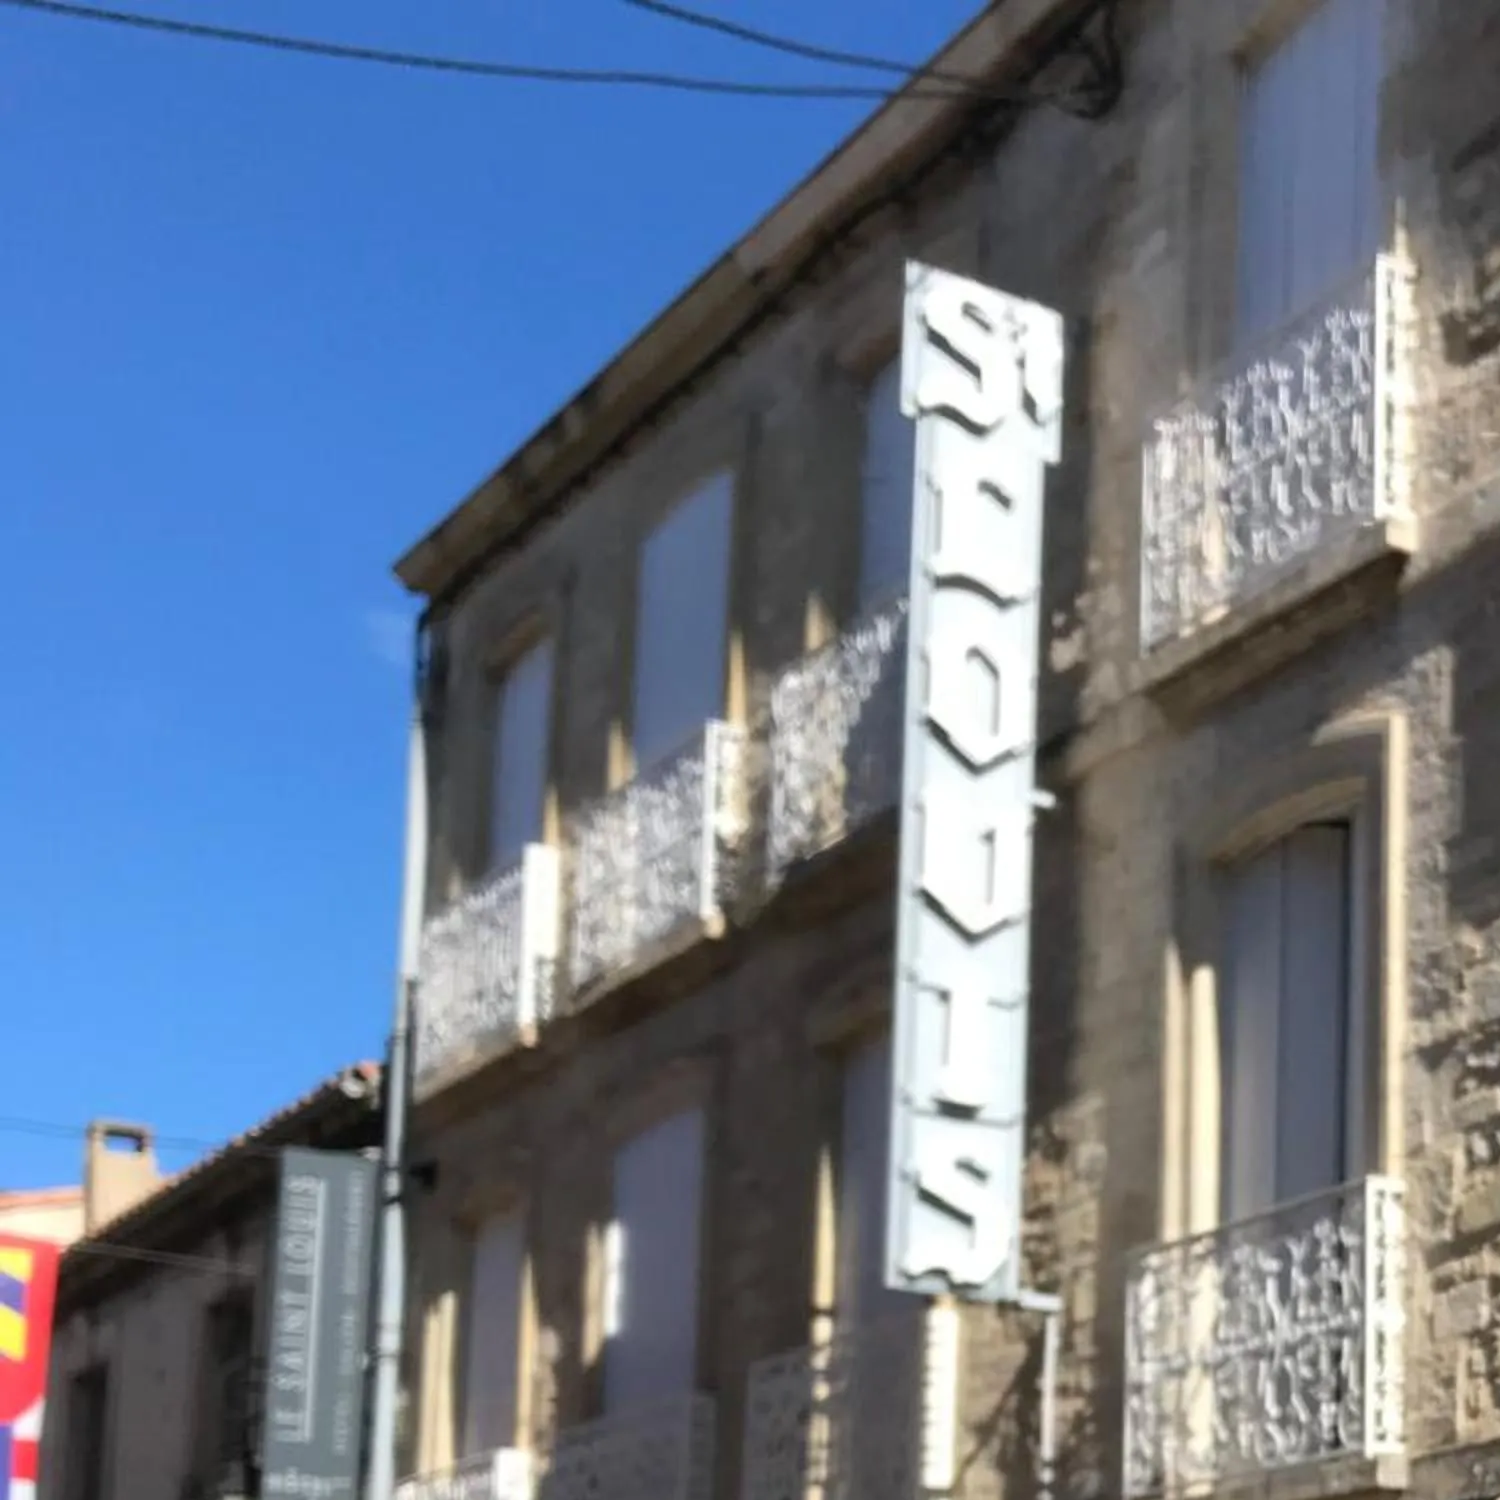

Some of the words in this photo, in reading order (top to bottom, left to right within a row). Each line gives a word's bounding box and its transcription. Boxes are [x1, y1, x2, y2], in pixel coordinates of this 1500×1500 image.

[282, 1173, 323, 1277] LOUIS
[274, 1288, 309, 1393] SAINT
[272, 1407, 306, 1444] LE
